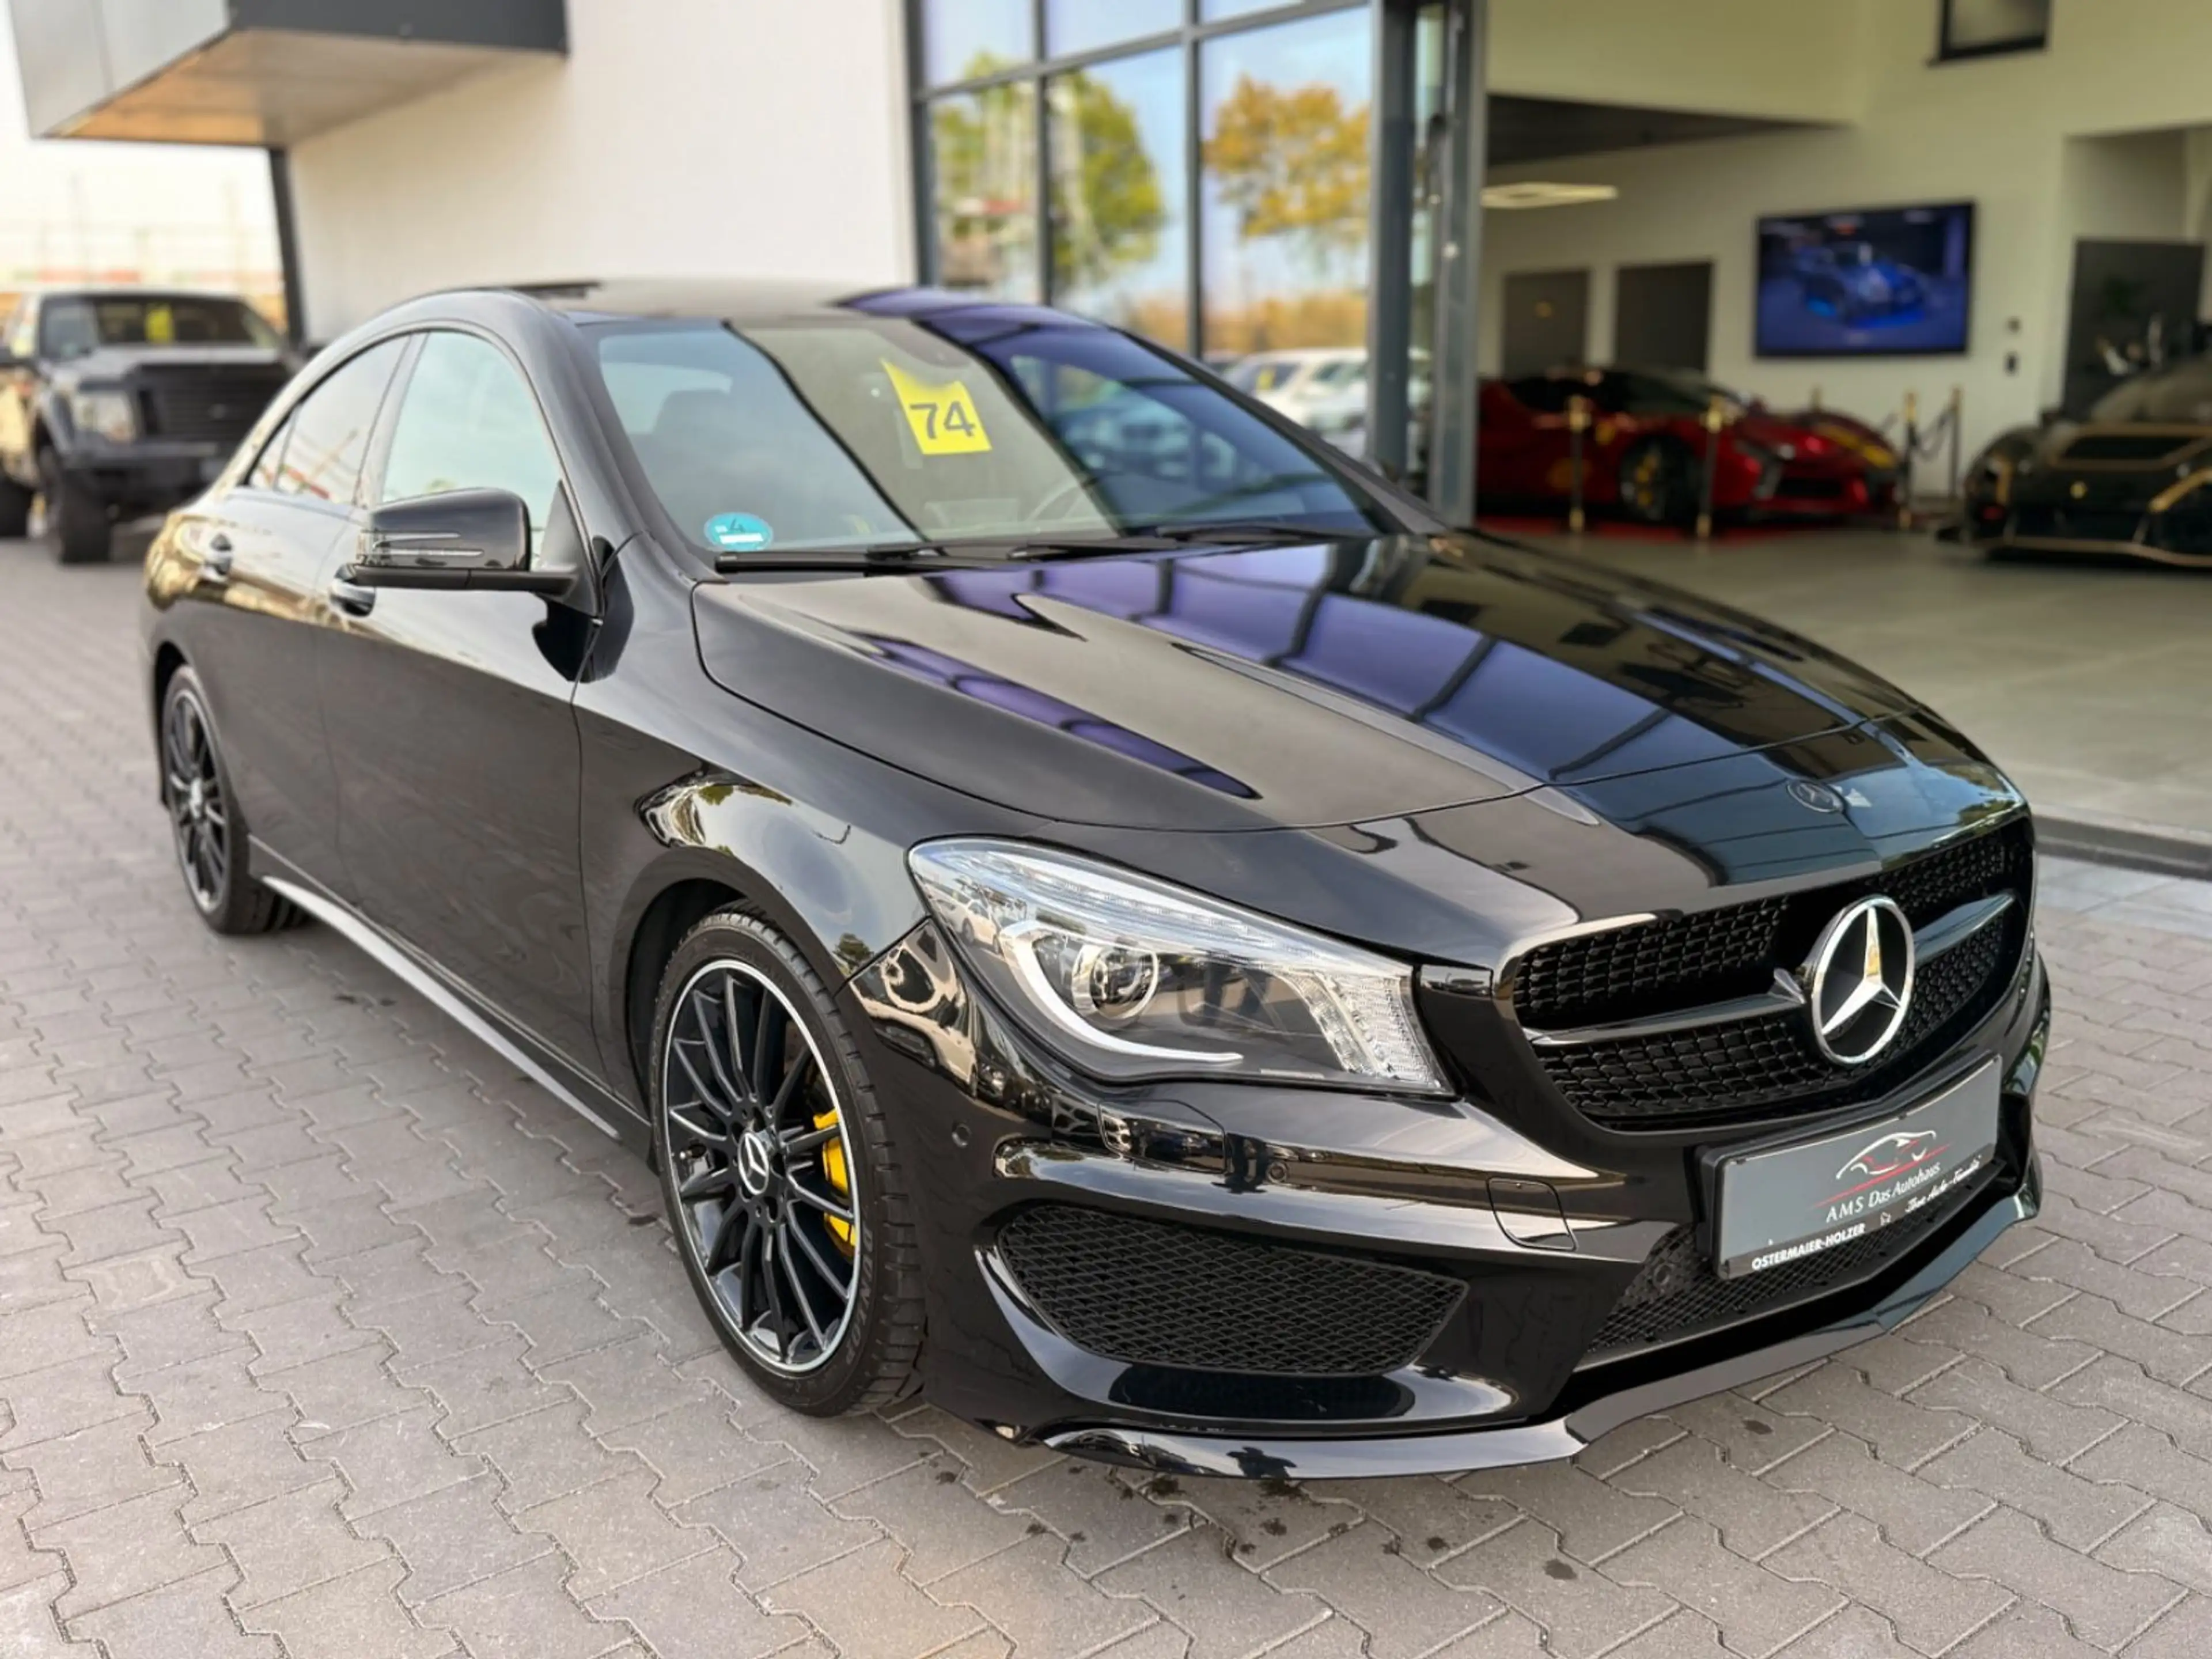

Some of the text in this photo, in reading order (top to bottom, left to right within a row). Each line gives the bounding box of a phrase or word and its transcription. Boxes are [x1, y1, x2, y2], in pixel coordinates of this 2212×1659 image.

[910, 401, 975, 440] 74
[1825, 1161, 1941, 1224] AMS Das Autohaus
[1751, 1223, 1866, 1271] OSTERMAIER-HOLZER
[845, 1223, 873, 1365] DUNLOP
